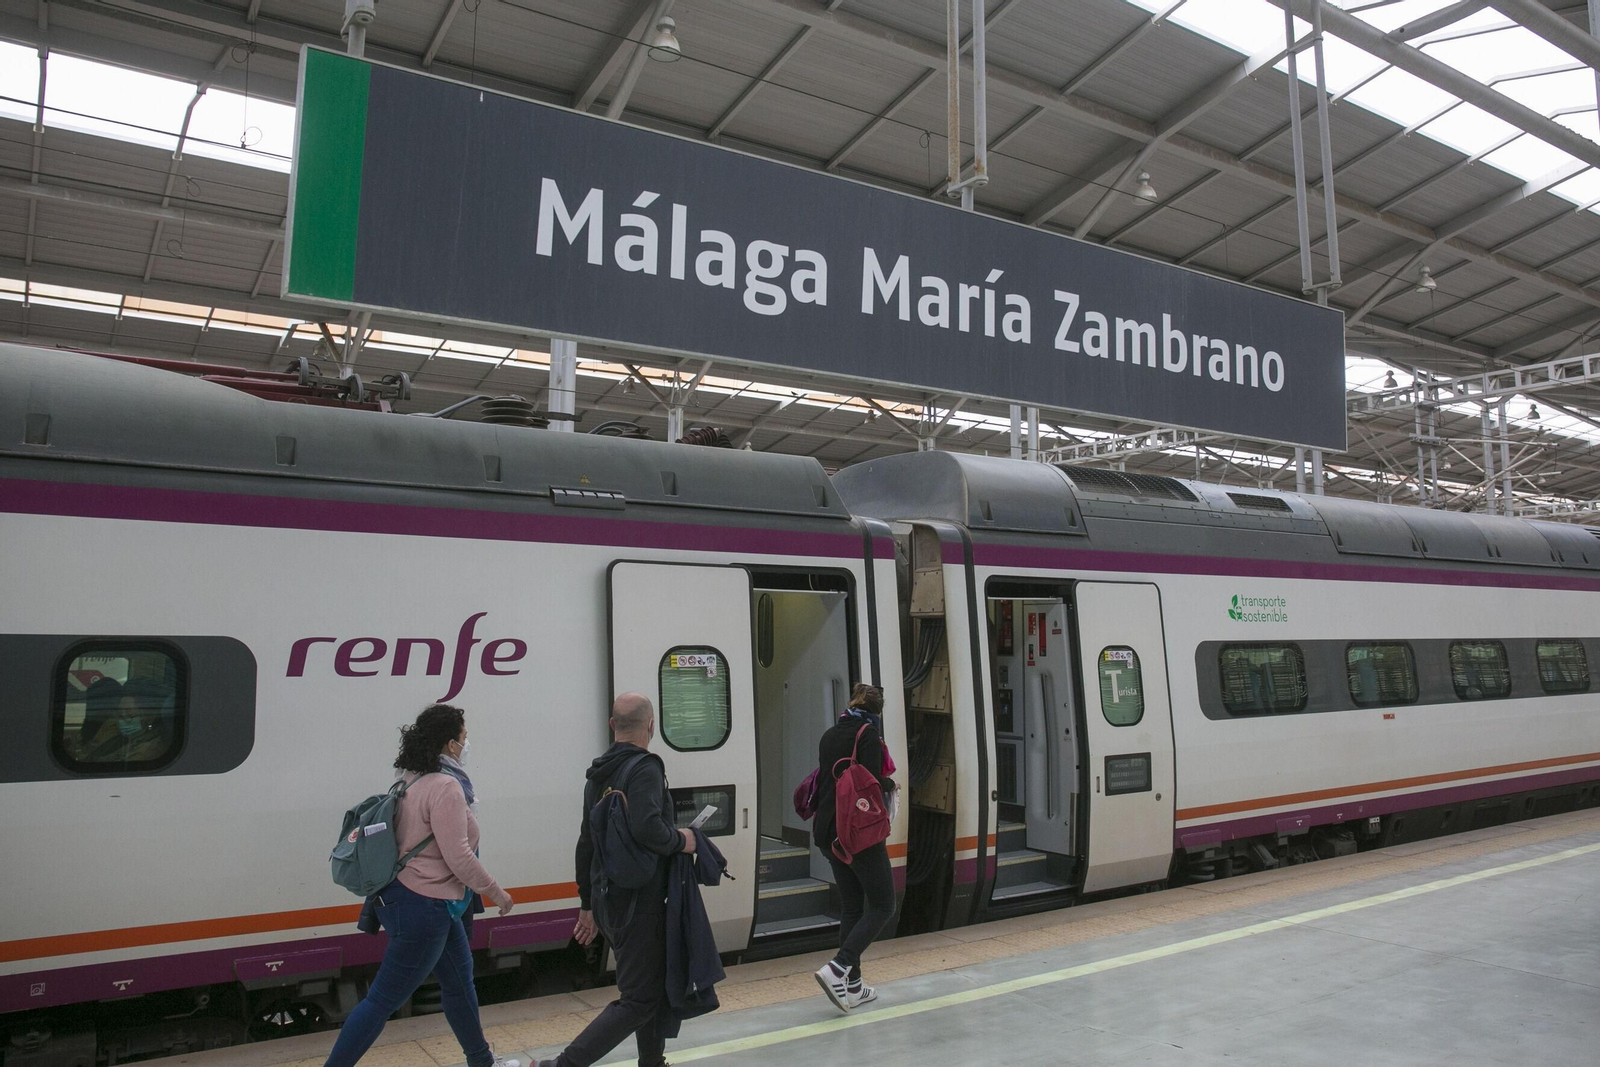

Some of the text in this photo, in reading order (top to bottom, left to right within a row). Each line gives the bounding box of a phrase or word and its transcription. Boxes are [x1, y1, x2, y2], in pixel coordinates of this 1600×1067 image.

[535, 177, 1285, 392] Málaga María Zambrano
[1241, 594, 1287, 610] transporte
[1242, 608, 1288, 622] sostenible
[285, 611, 528, 704] renfe
[1104, 669, 1138, 703] Turista
